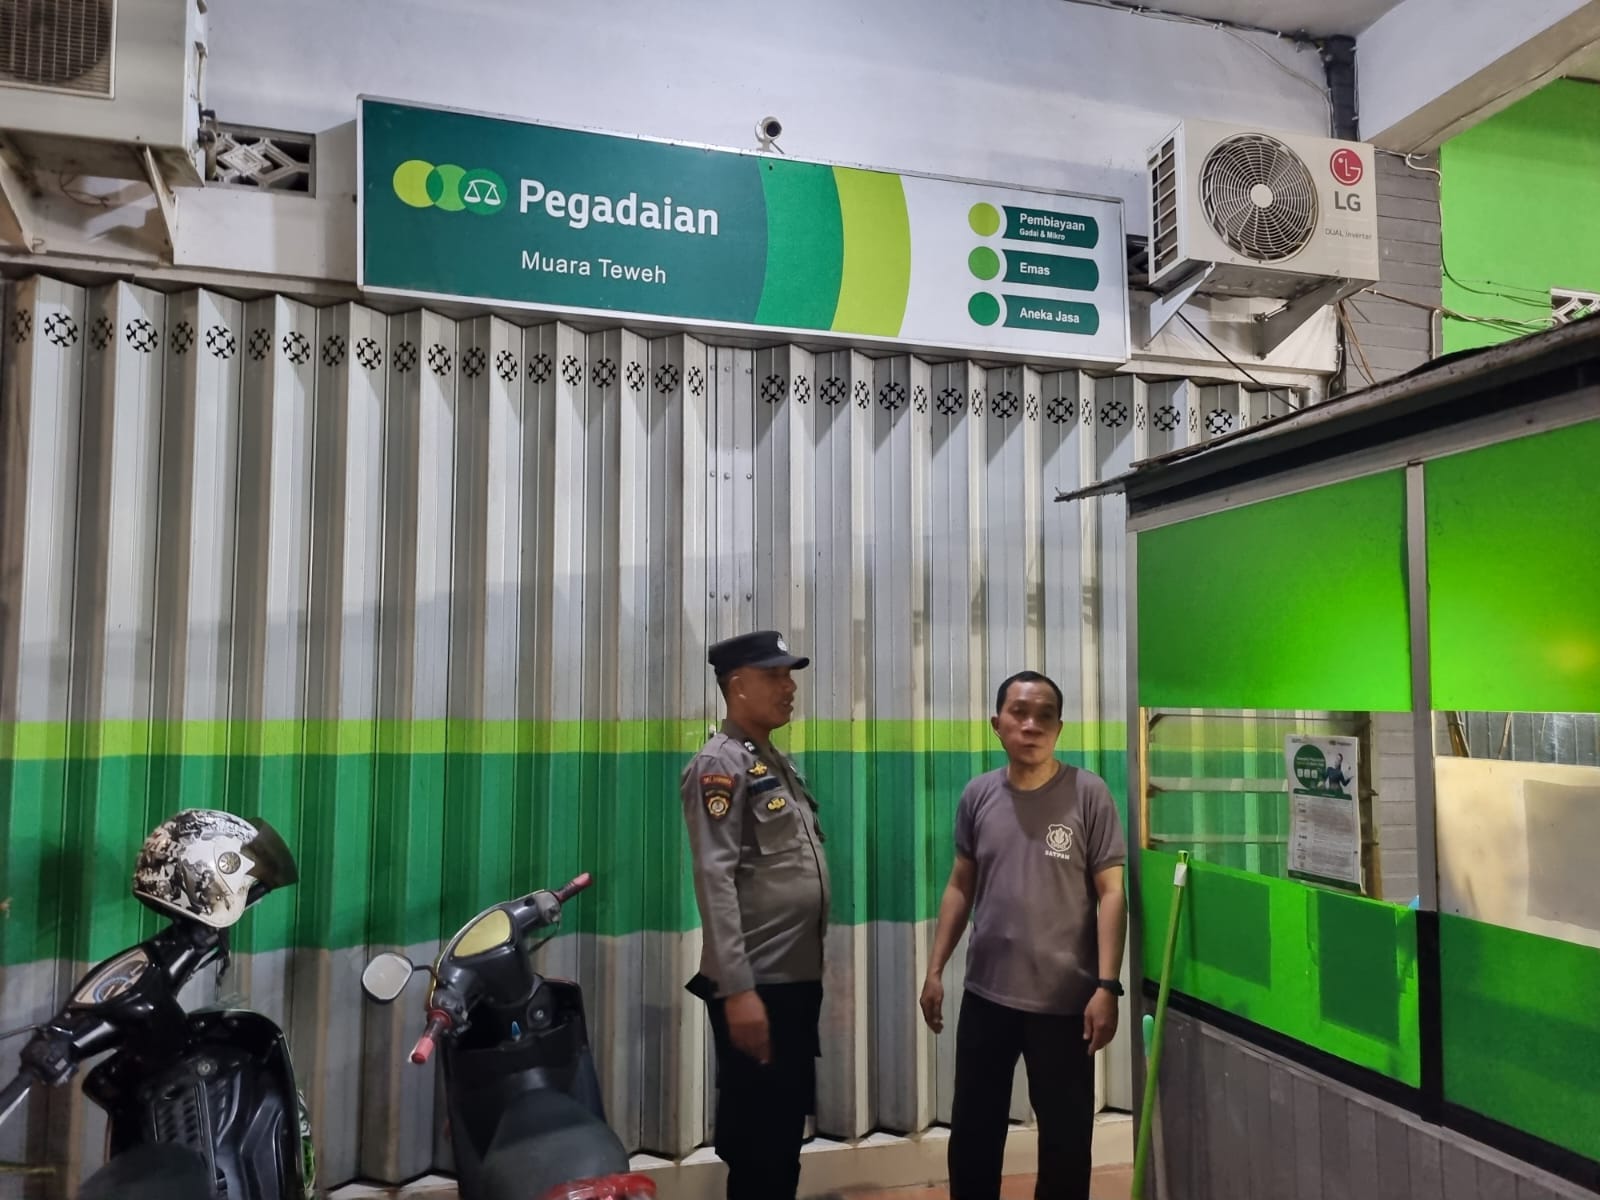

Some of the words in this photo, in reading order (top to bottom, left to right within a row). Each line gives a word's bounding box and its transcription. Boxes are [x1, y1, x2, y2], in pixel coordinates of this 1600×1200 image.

[519, 178, 719, 236] Pegadaian
[1334, 190, 1361, 212] LG
[1019, 212, 1086, 231] Pembiayaan
[1019, 228, 1039, 238] Gadai
[1040, 230, 1046, 238] &
[1047, 231, 1066, 241] Mikro
[1325, 227, 1344, 237] DUAL
[520, 250, 591, 276] Muara
[598, 258, 667, 285] Teweh
[1019, 262, 1050, 276] Emas
[1019, 307, 1053, 321] Aneka
[1055, 311, 1080, 324] Jasa
